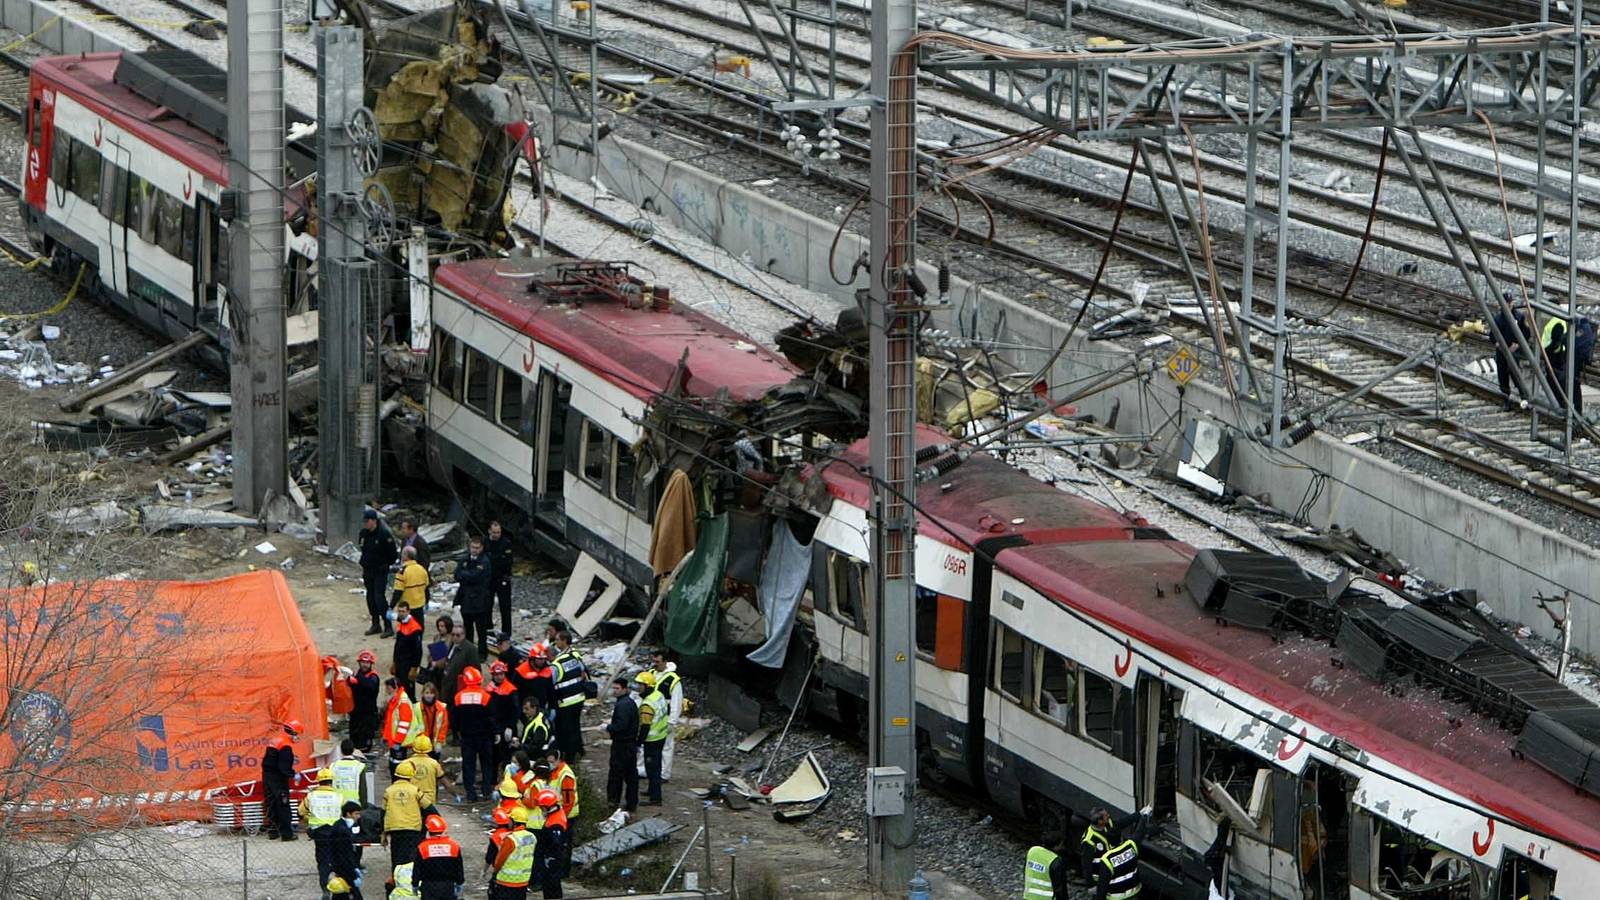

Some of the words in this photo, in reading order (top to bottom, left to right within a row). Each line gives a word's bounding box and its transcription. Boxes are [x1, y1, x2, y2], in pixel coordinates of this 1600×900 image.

[1175, 357, 1191, 372] 30
[944, 554, 967, 576] 096R
[175, 756, 215, 771] Las
